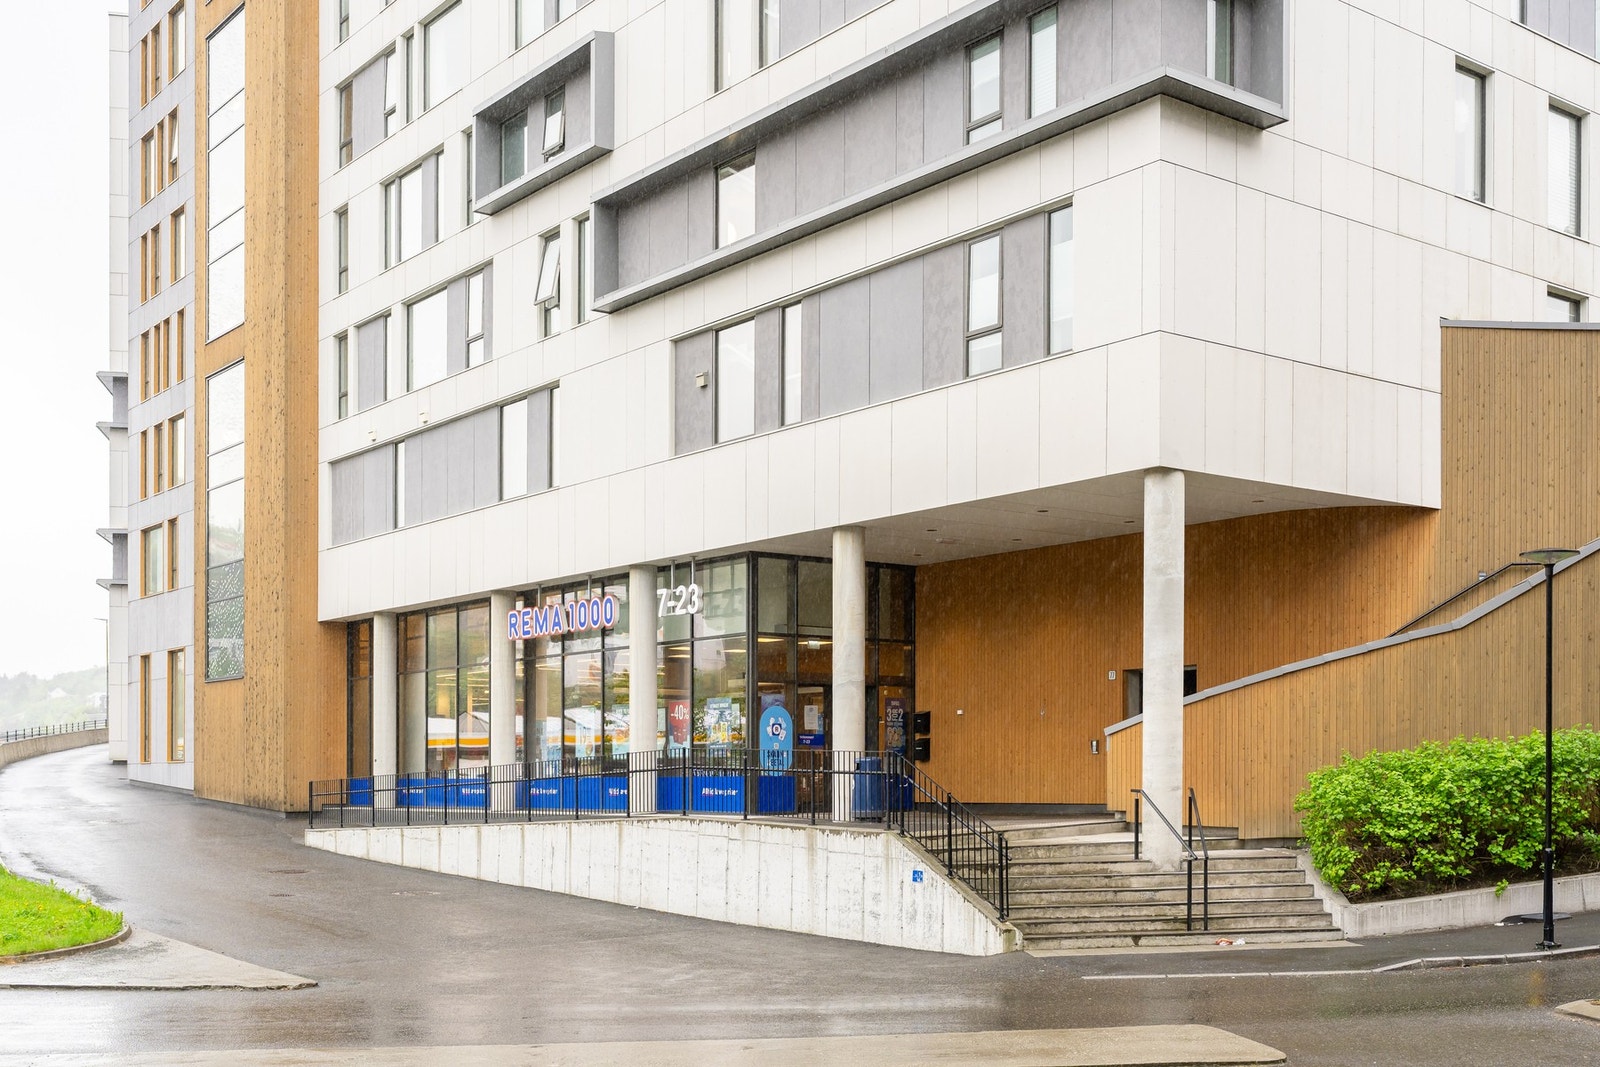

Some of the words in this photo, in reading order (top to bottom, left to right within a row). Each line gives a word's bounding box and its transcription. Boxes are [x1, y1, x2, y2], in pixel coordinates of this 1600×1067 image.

[656, 583, 701, 618] 7-23
[507, 604, 563, 640] REMA
[567, 594, 616, 633] 1000
[670, 704, 690, 720] -40%
[886, 708, 892, 721] 3
[898, 708, 904, 721] 2
